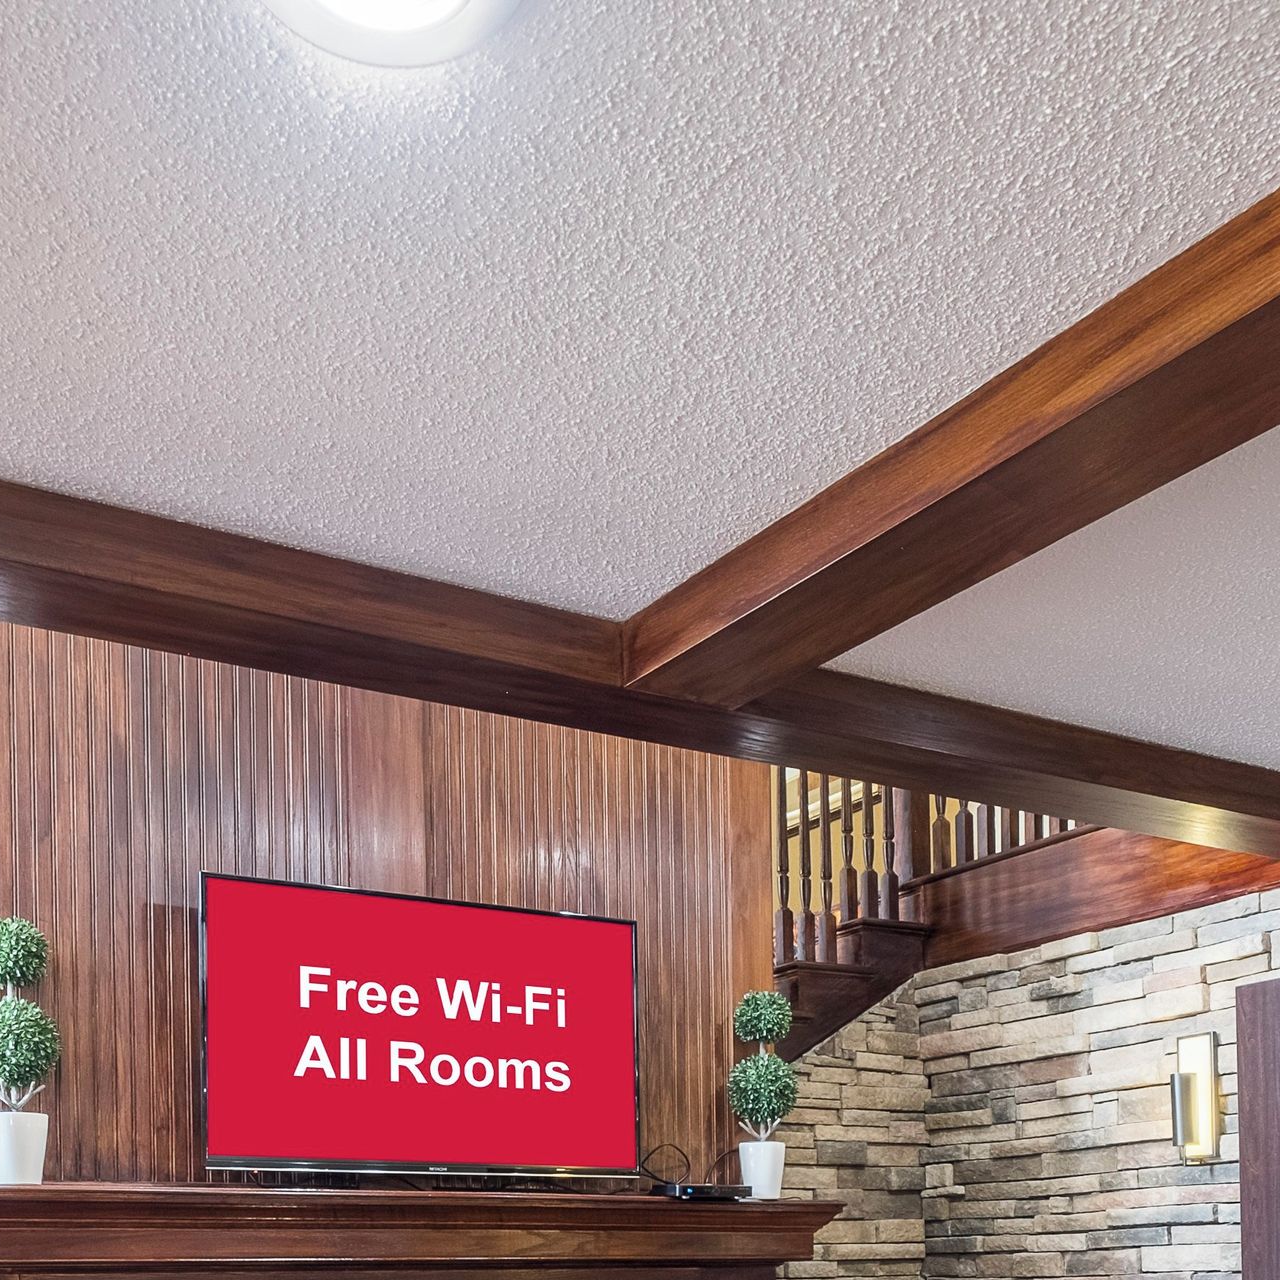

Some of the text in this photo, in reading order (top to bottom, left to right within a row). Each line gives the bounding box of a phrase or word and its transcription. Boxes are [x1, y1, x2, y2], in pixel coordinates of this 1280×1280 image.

[300, 966, 565, 1027] Free Wi-Fi
[294, 1035, 570, 1092] All Rooms
